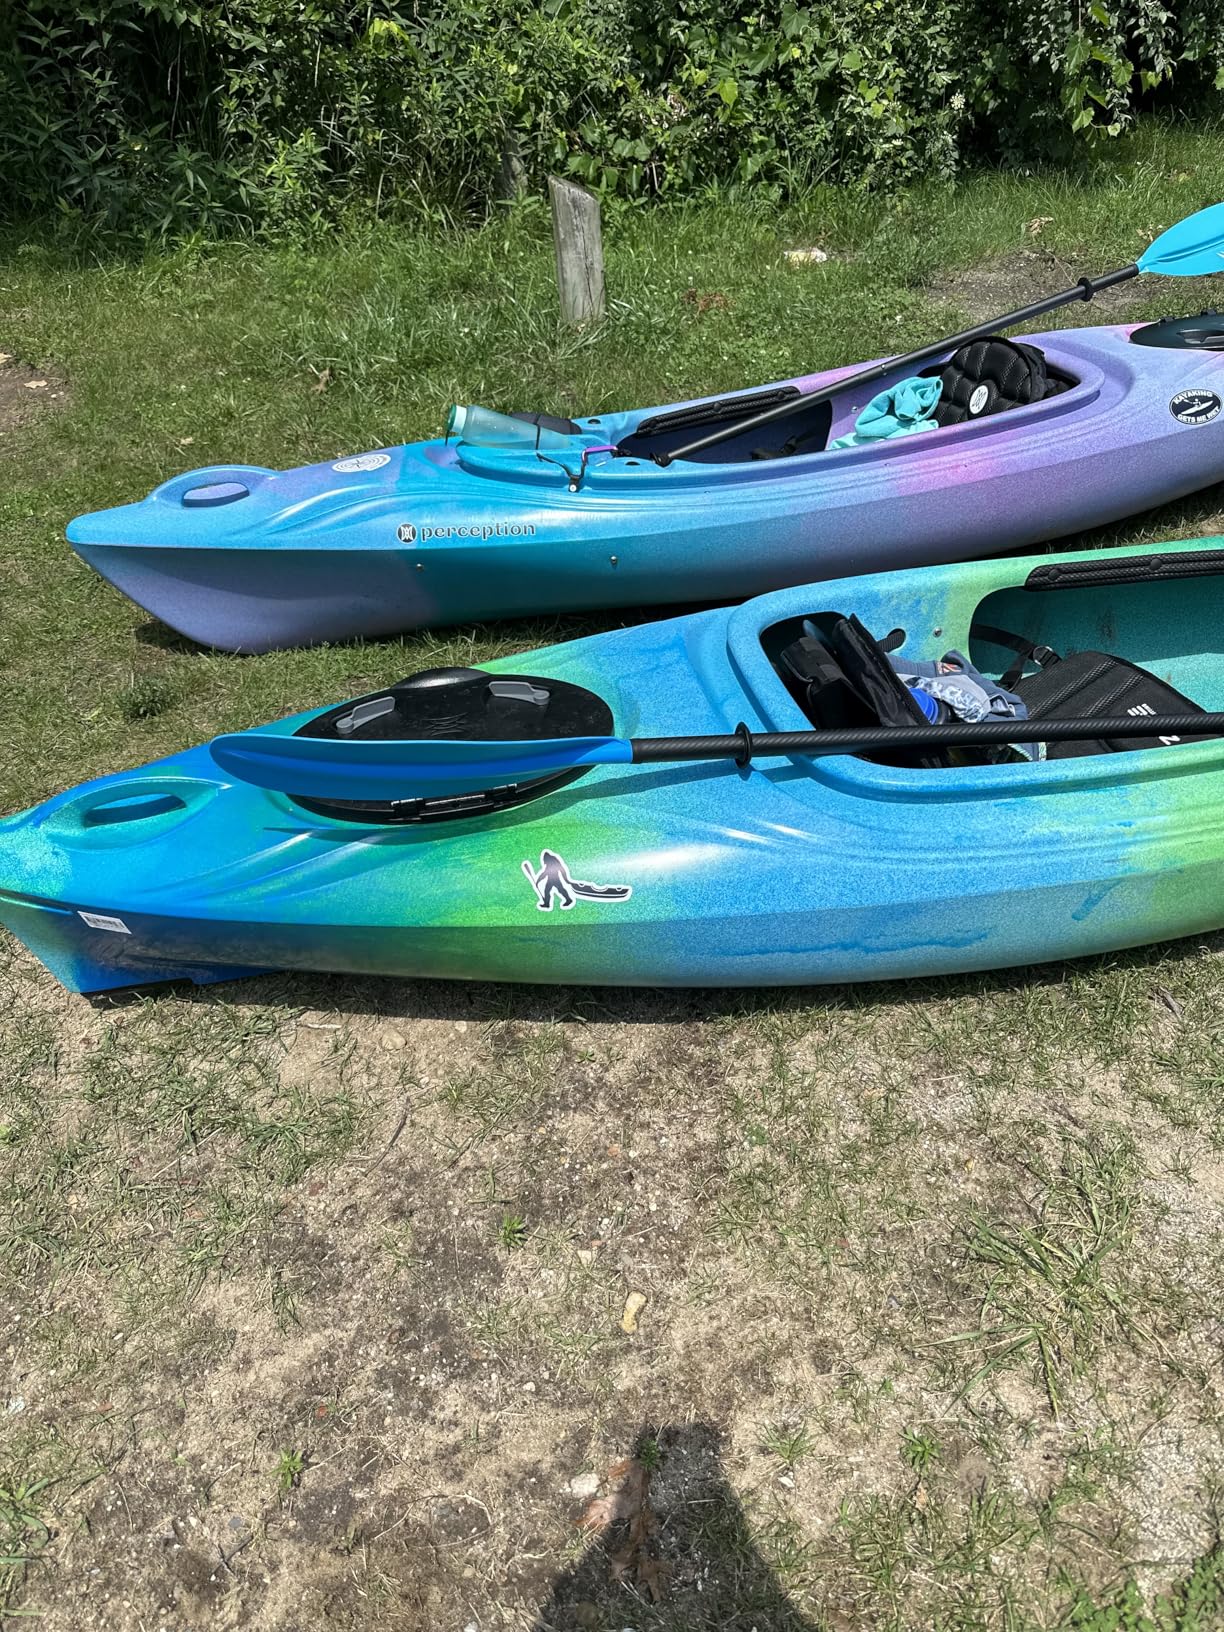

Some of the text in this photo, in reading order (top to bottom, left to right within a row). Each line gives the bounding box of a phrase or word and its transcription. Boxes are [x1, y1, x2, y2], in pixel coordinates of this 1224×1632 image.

[1173, 390, 1213, 404] KAYAKING
[1177, 413, 1195, 422] GETS
[420, 521, 536, 542] perception
